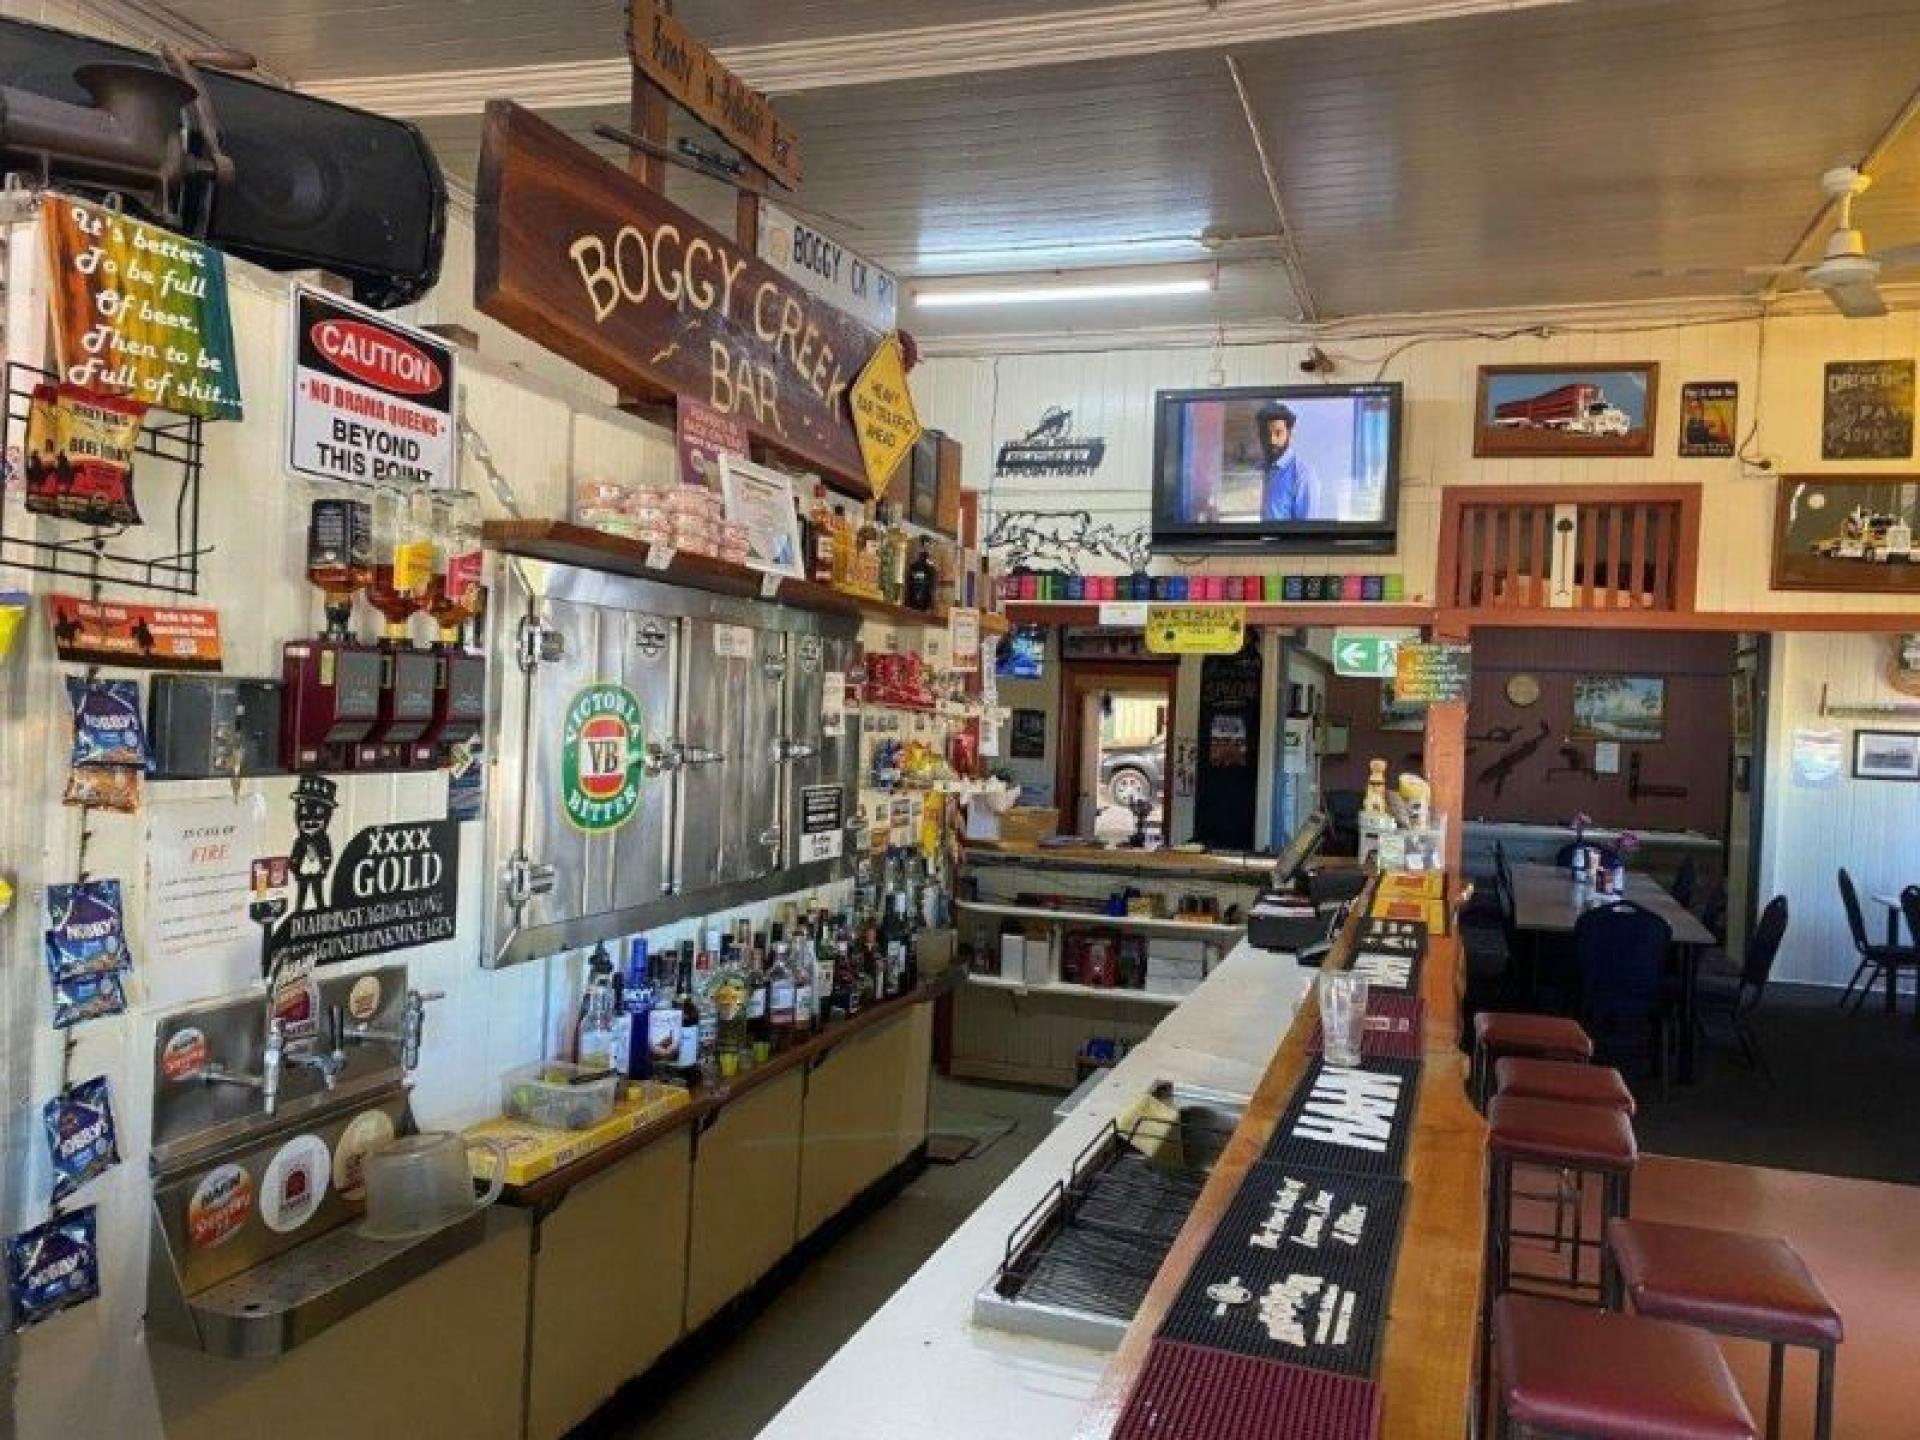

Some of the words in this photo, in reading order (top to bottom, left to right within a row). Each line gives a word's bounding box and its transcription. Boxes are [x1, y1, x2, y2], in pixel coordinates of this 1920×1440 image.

[134, 228, 205, 267] better
[794, 225, 841, 283] BOGGY
[75, 247, 117, 274] To
[127, 259, 154, 283] be
[160, 269, 206, 299] full
[96, 289, 136, 325] Of
[569, 225, 747, 323] BOGGY
[756, 282, 847, 424] CREEK
[82, 324, 158, 359] Then
[166, 347, 189, 364] to
[197, 349, 222, 372] be
[321, 325, 432, 386] CAUTION
[69, 357, 139, 387] Full
[144, 371, 174, 402] of
[710, 340, 788, 439] BAR
[310, 379, 331, 404] NO
[334, 386, 385, 421] DRAMA
[388, 405, 438, 438] QUEENS
[316, 441, 366, 476] THIS
[333, 417, 421, 461] BEYOND
[565, 691, 640, 746] VICTORIA
[587, 740, 619, 774] VB
[568, 785, 637, 822] BITTER
[367, 827, 431, 855] XXXX
[353, 852, 442, 896] GOLD
